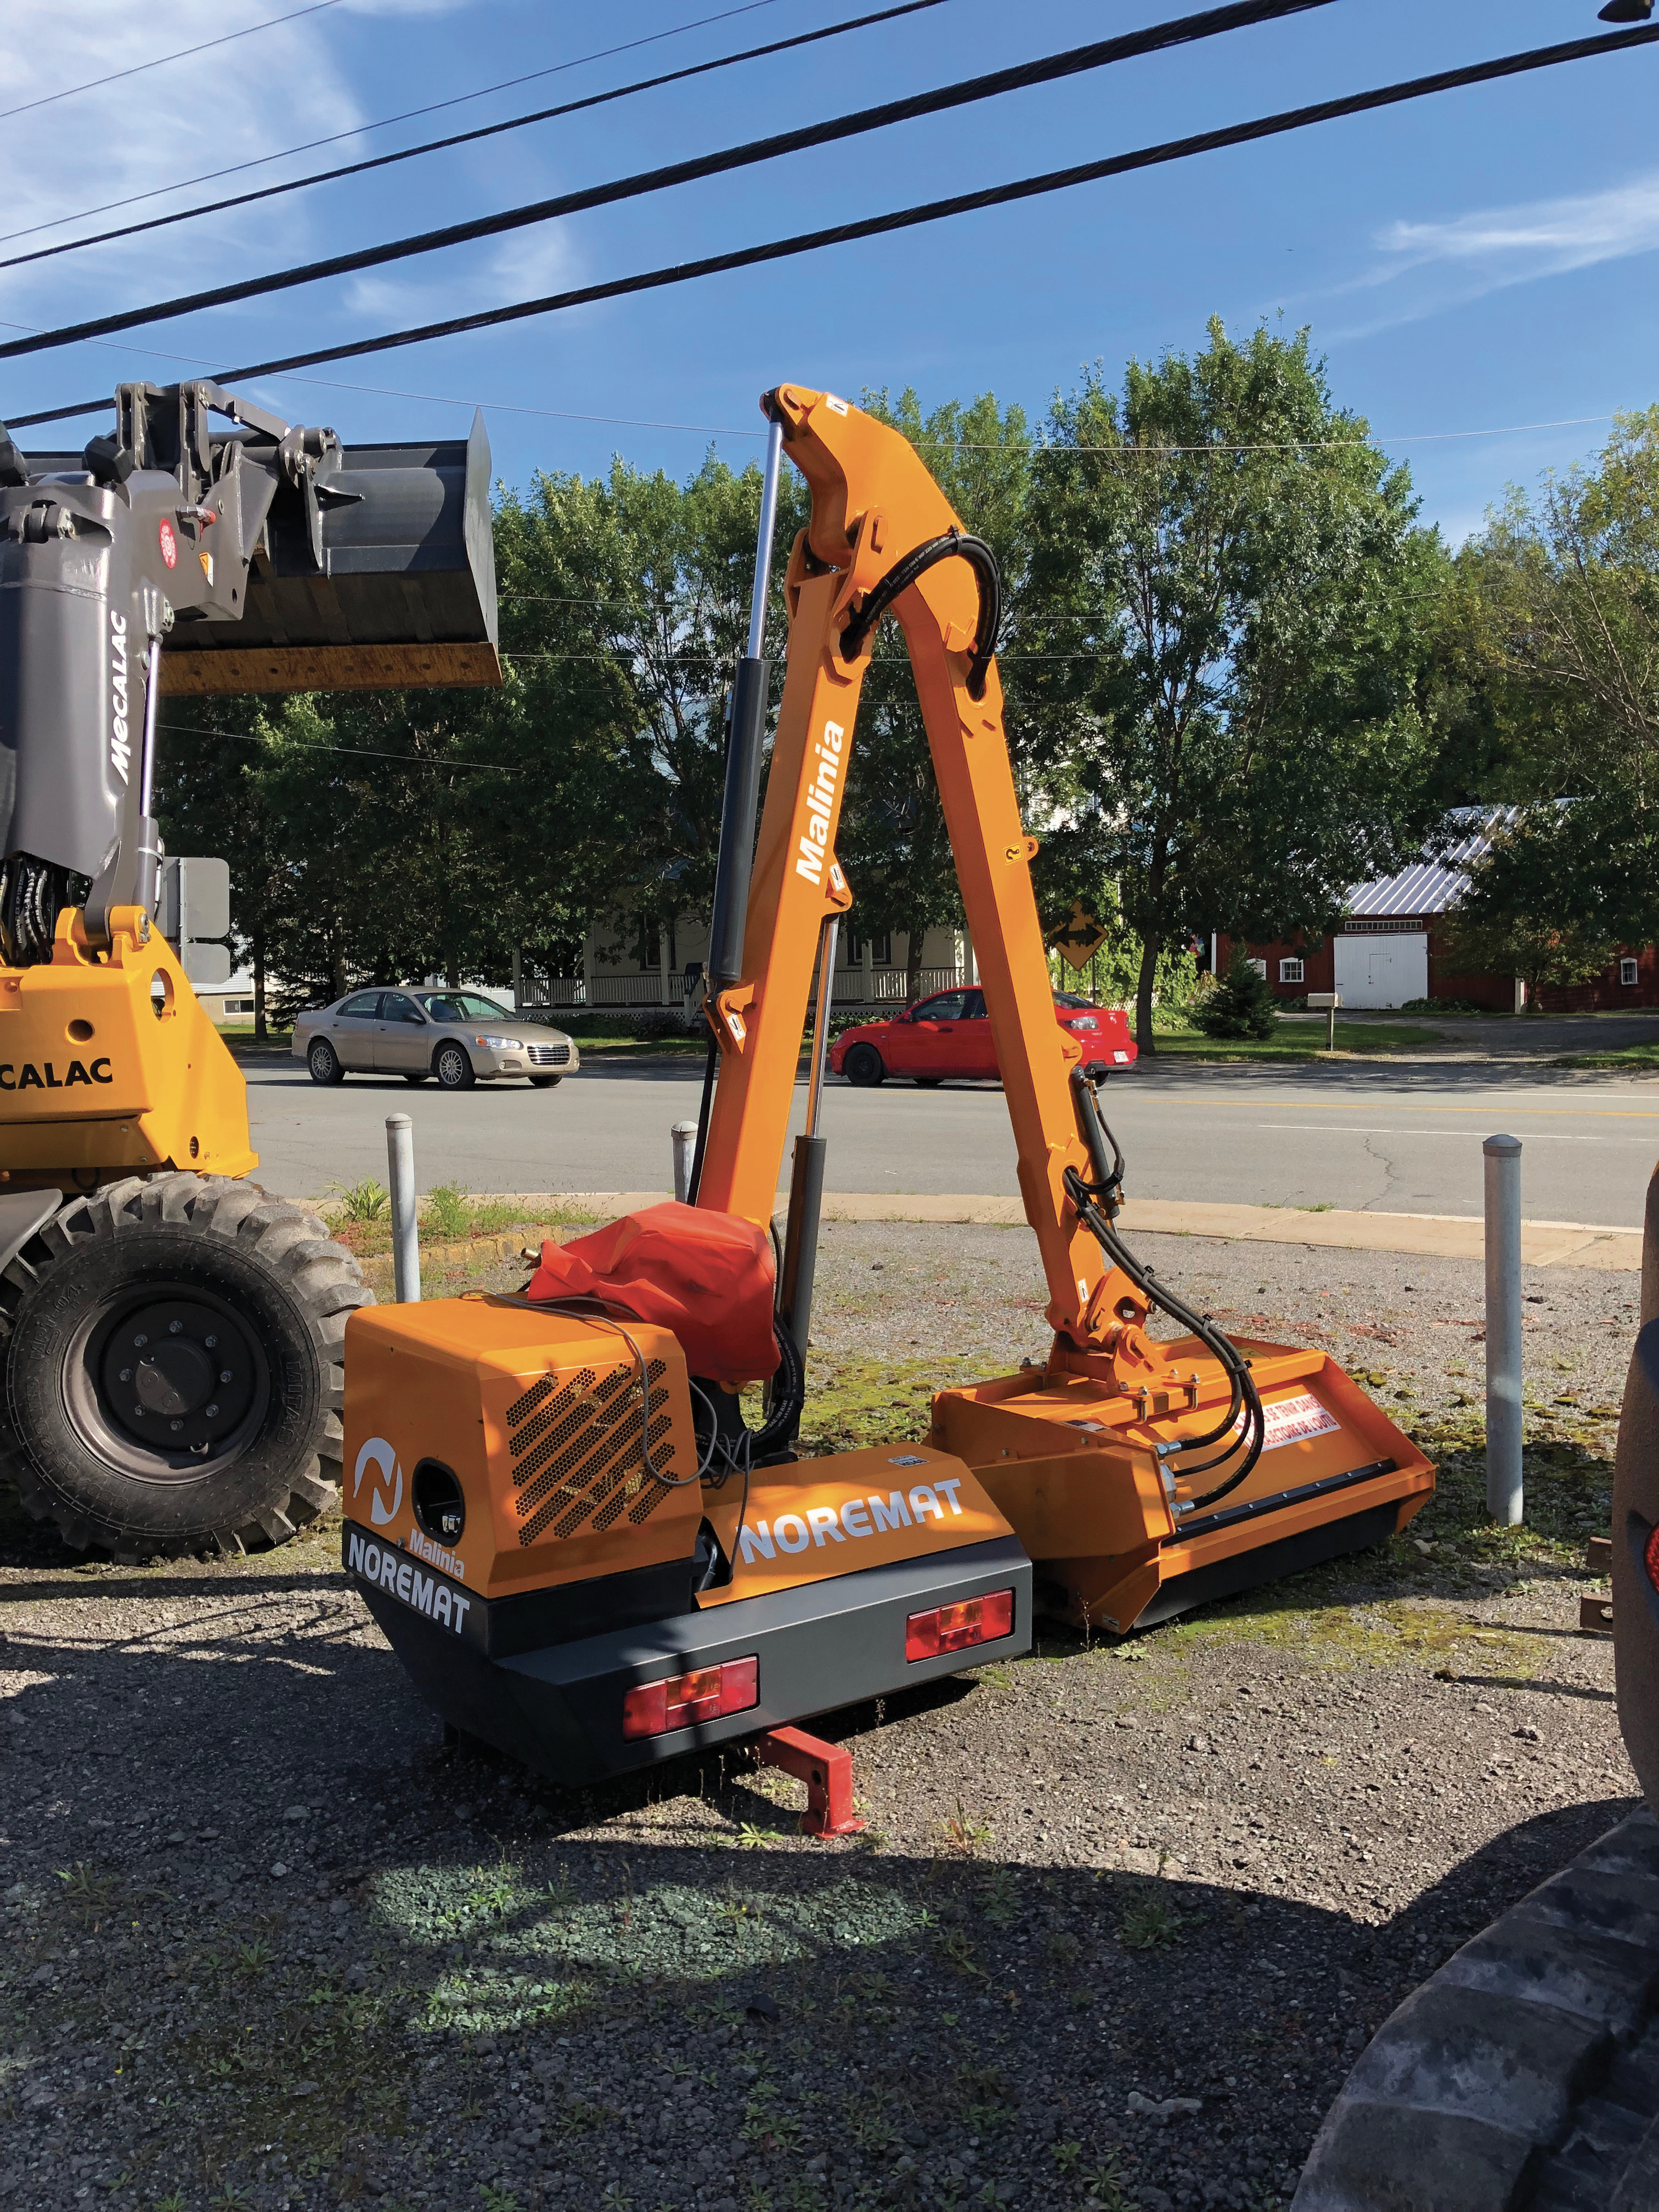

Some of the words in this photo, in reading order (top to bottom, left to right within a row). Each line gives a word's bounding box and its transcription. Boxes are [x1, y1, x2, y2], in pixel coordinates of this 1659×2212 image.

[795, 720, 844, 885] Malinia
[278, 1361, 303, 1444] MITAS
[1295, 1396, 1321, 1413] DANS
[410, 1528, 465, 1579] Malinia
[736, 1479, 962, 1564] NOREMAT
[349, 1533, 470, 1633] NOREMAT
